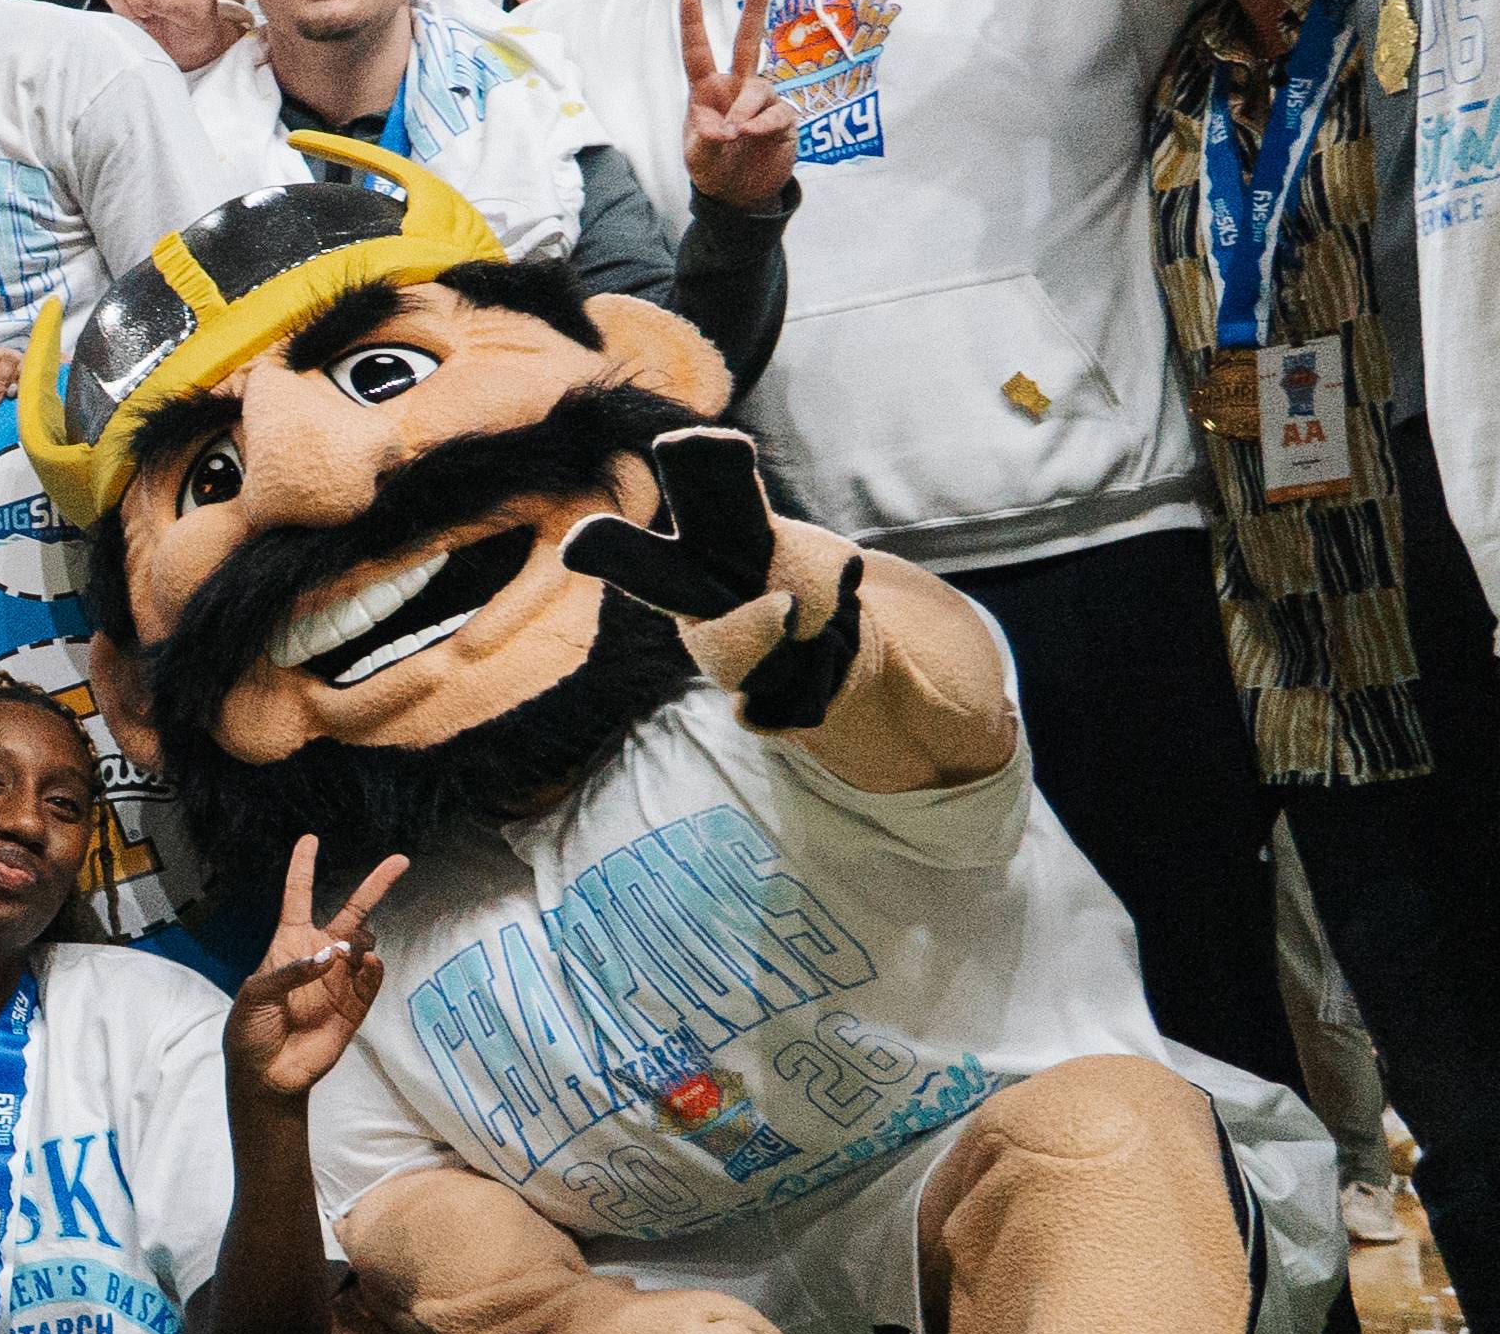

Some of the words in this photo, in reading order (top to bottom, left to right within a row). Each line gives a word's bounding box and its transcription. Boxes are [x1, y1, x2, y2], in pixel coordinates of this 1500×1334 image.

[797, 95, 879, 158] GSKY
[1282, 418, 1328, 449] AA
[772, 1012, 920, 1129] 26
